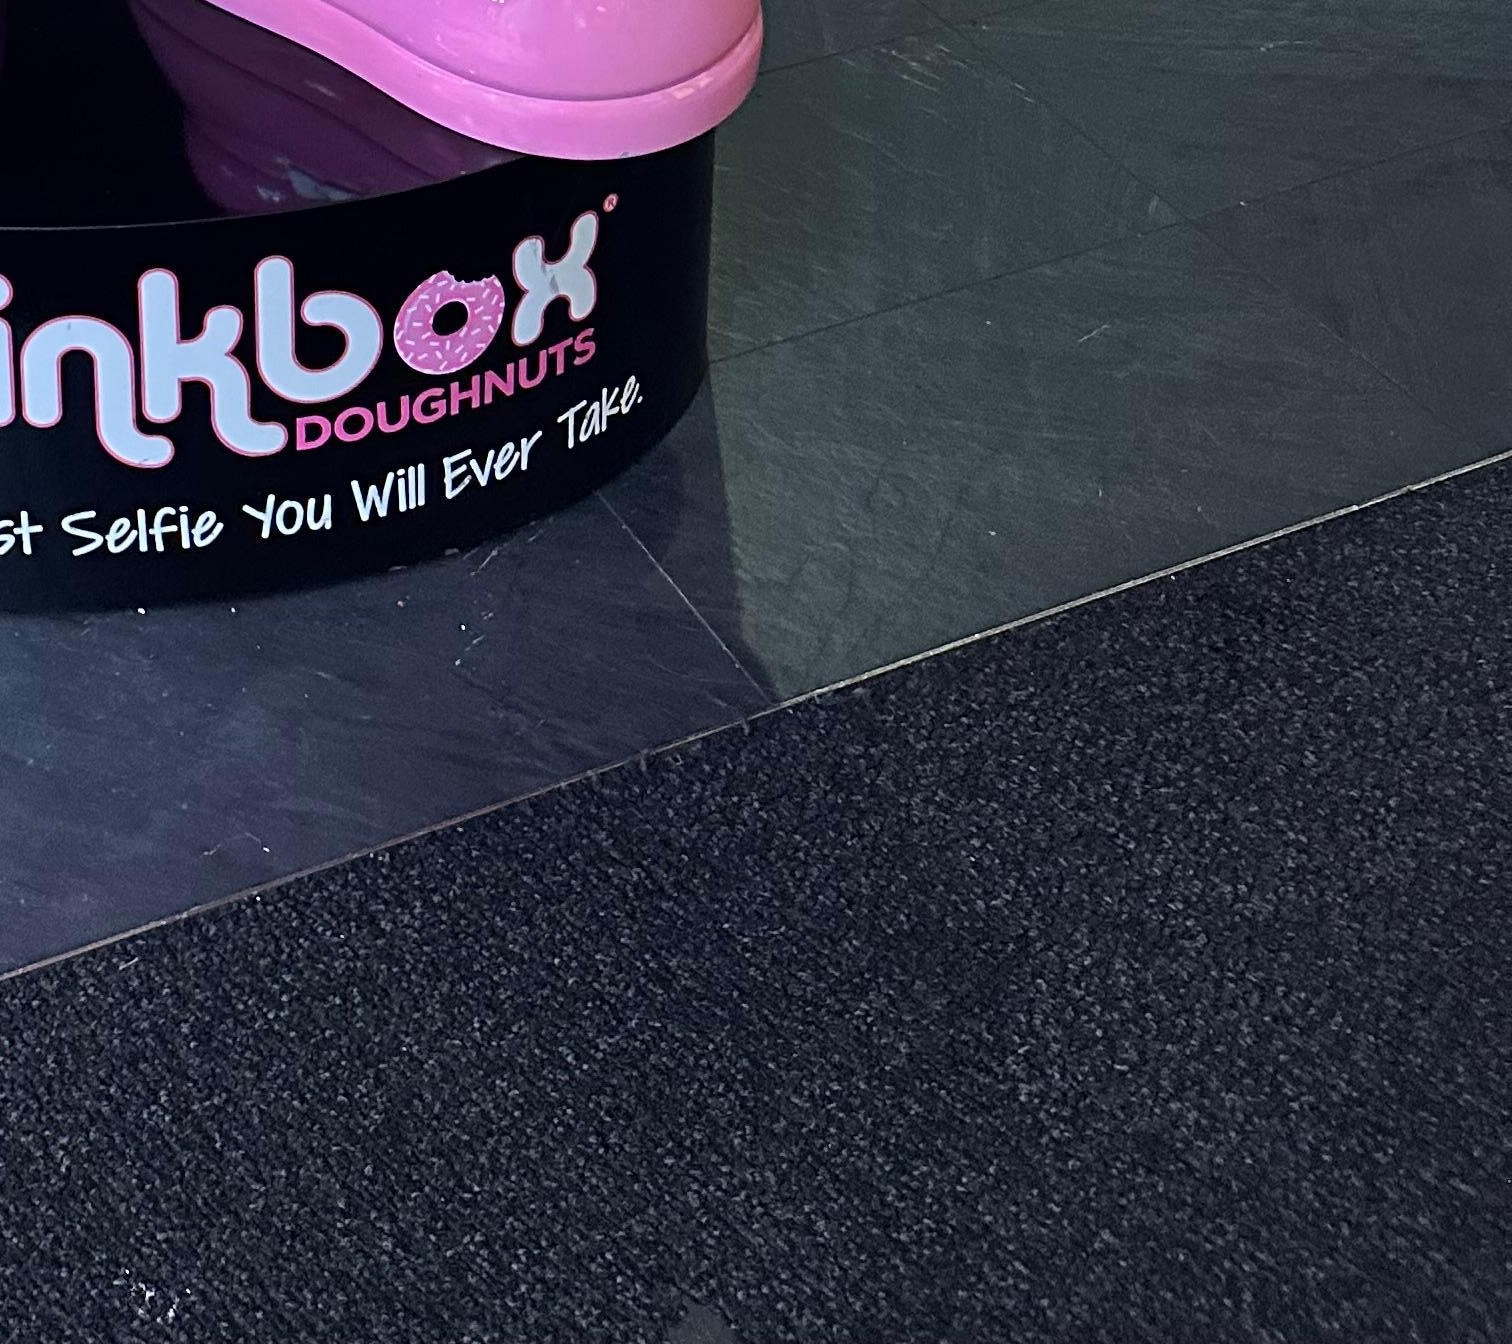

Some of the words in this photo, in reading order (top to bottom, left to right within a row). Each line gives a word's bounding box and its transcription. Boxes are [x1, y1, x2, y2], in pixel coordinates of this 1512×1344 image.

[296, 328, 597, 450] DOUGHNUTS
[61, 505, 224, 557] Selfie
[242, 494, 332, 539] You
[351, 463, 426, 522] Will
[443, 430, 543, 499] Ever
[557, 375, 644, 449] Take.
